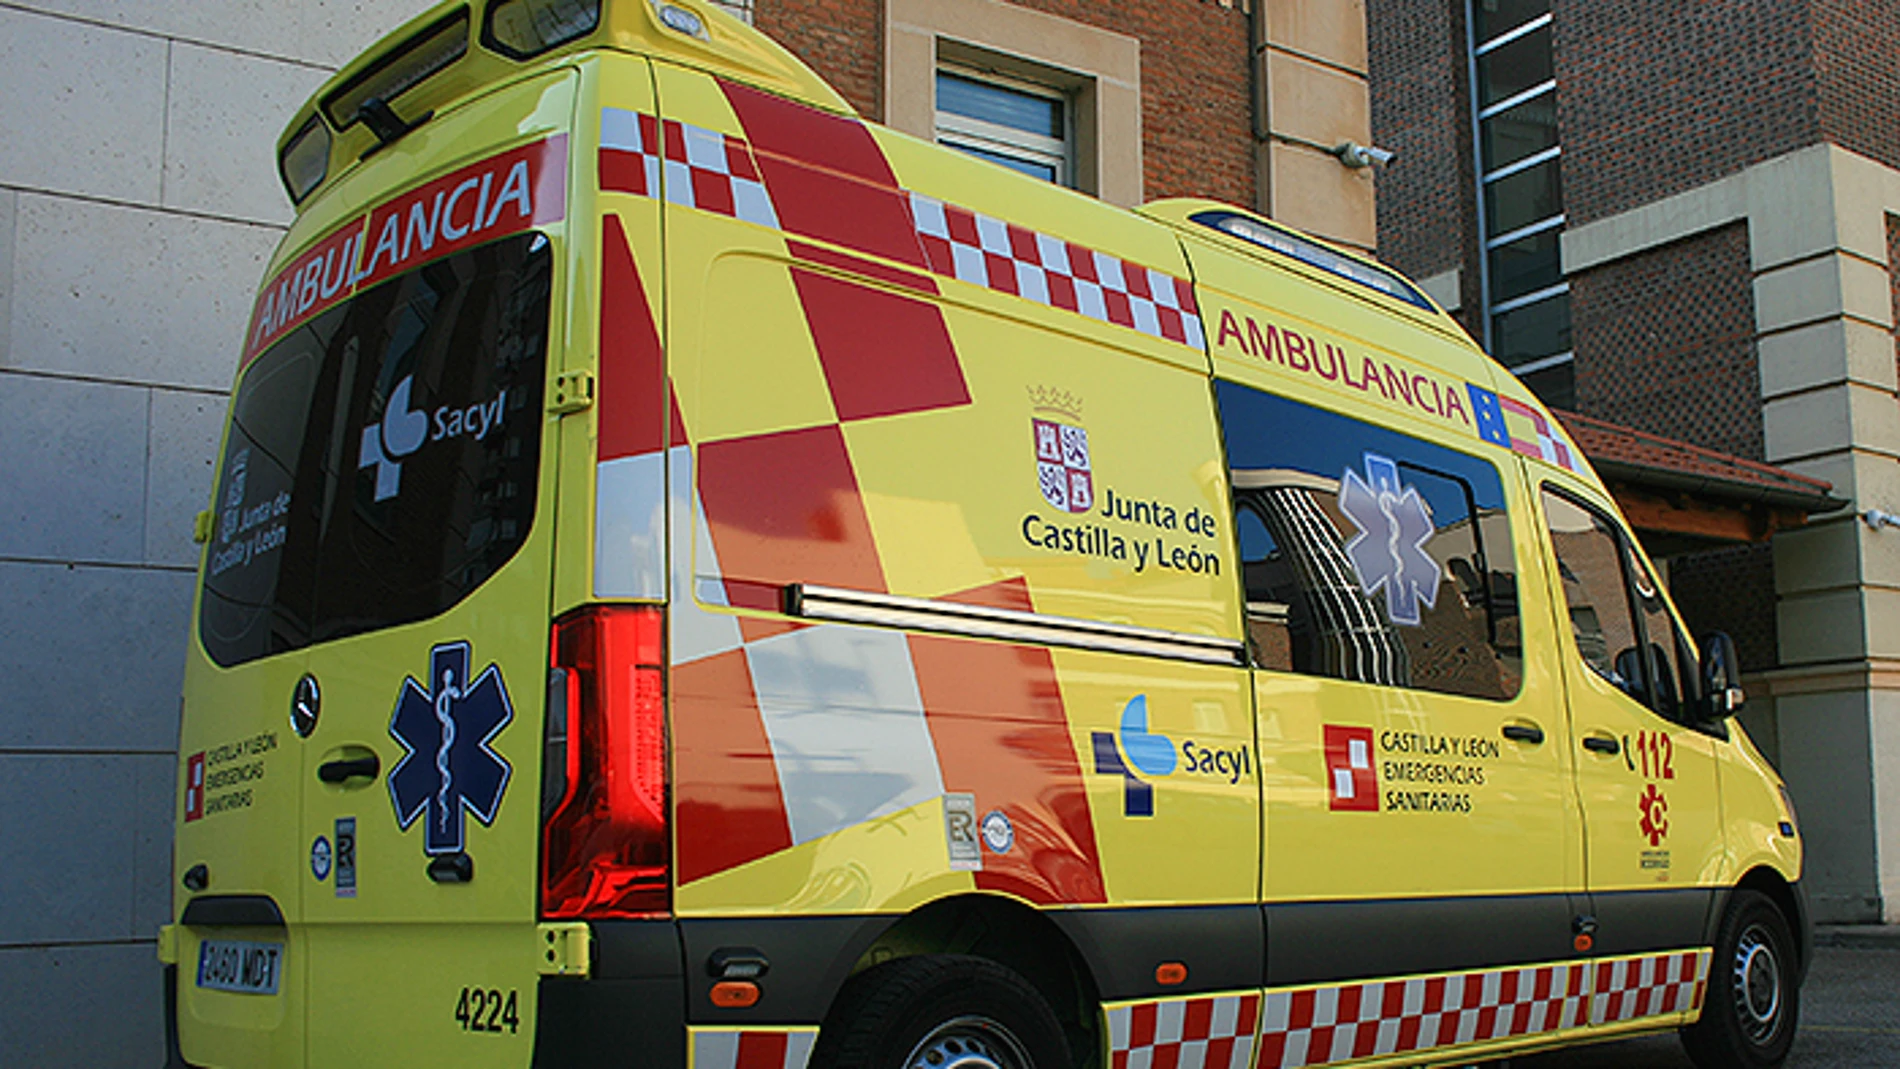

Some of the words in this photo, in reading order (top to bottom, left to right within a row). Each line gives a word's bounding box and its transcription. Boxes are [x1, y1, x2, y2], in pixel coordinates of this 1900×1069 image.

[252, 160, 532, 347] AMBULANCIA
[1217, 309, 1468, 425] AMBULANCIA
[431, 391, 505, 441] Sacyl
[1101, 489, 1177, 530] Junta
[1184, 507, 1215, 538] de
[1022, 515, 1127, 560] Castilla
[1133, 541, 1149, 573] y
[1156, 538, 1220, 576] León
[1183, 741, 1251, 784] Sacyl
[1384, 761, 1485, 785] EMERGENCIAS
[1638, 730, 1674, 779] 112
[1386, 791, 1472, 813] SANITARIAS
[455, 987, 519, 1034] 4224
